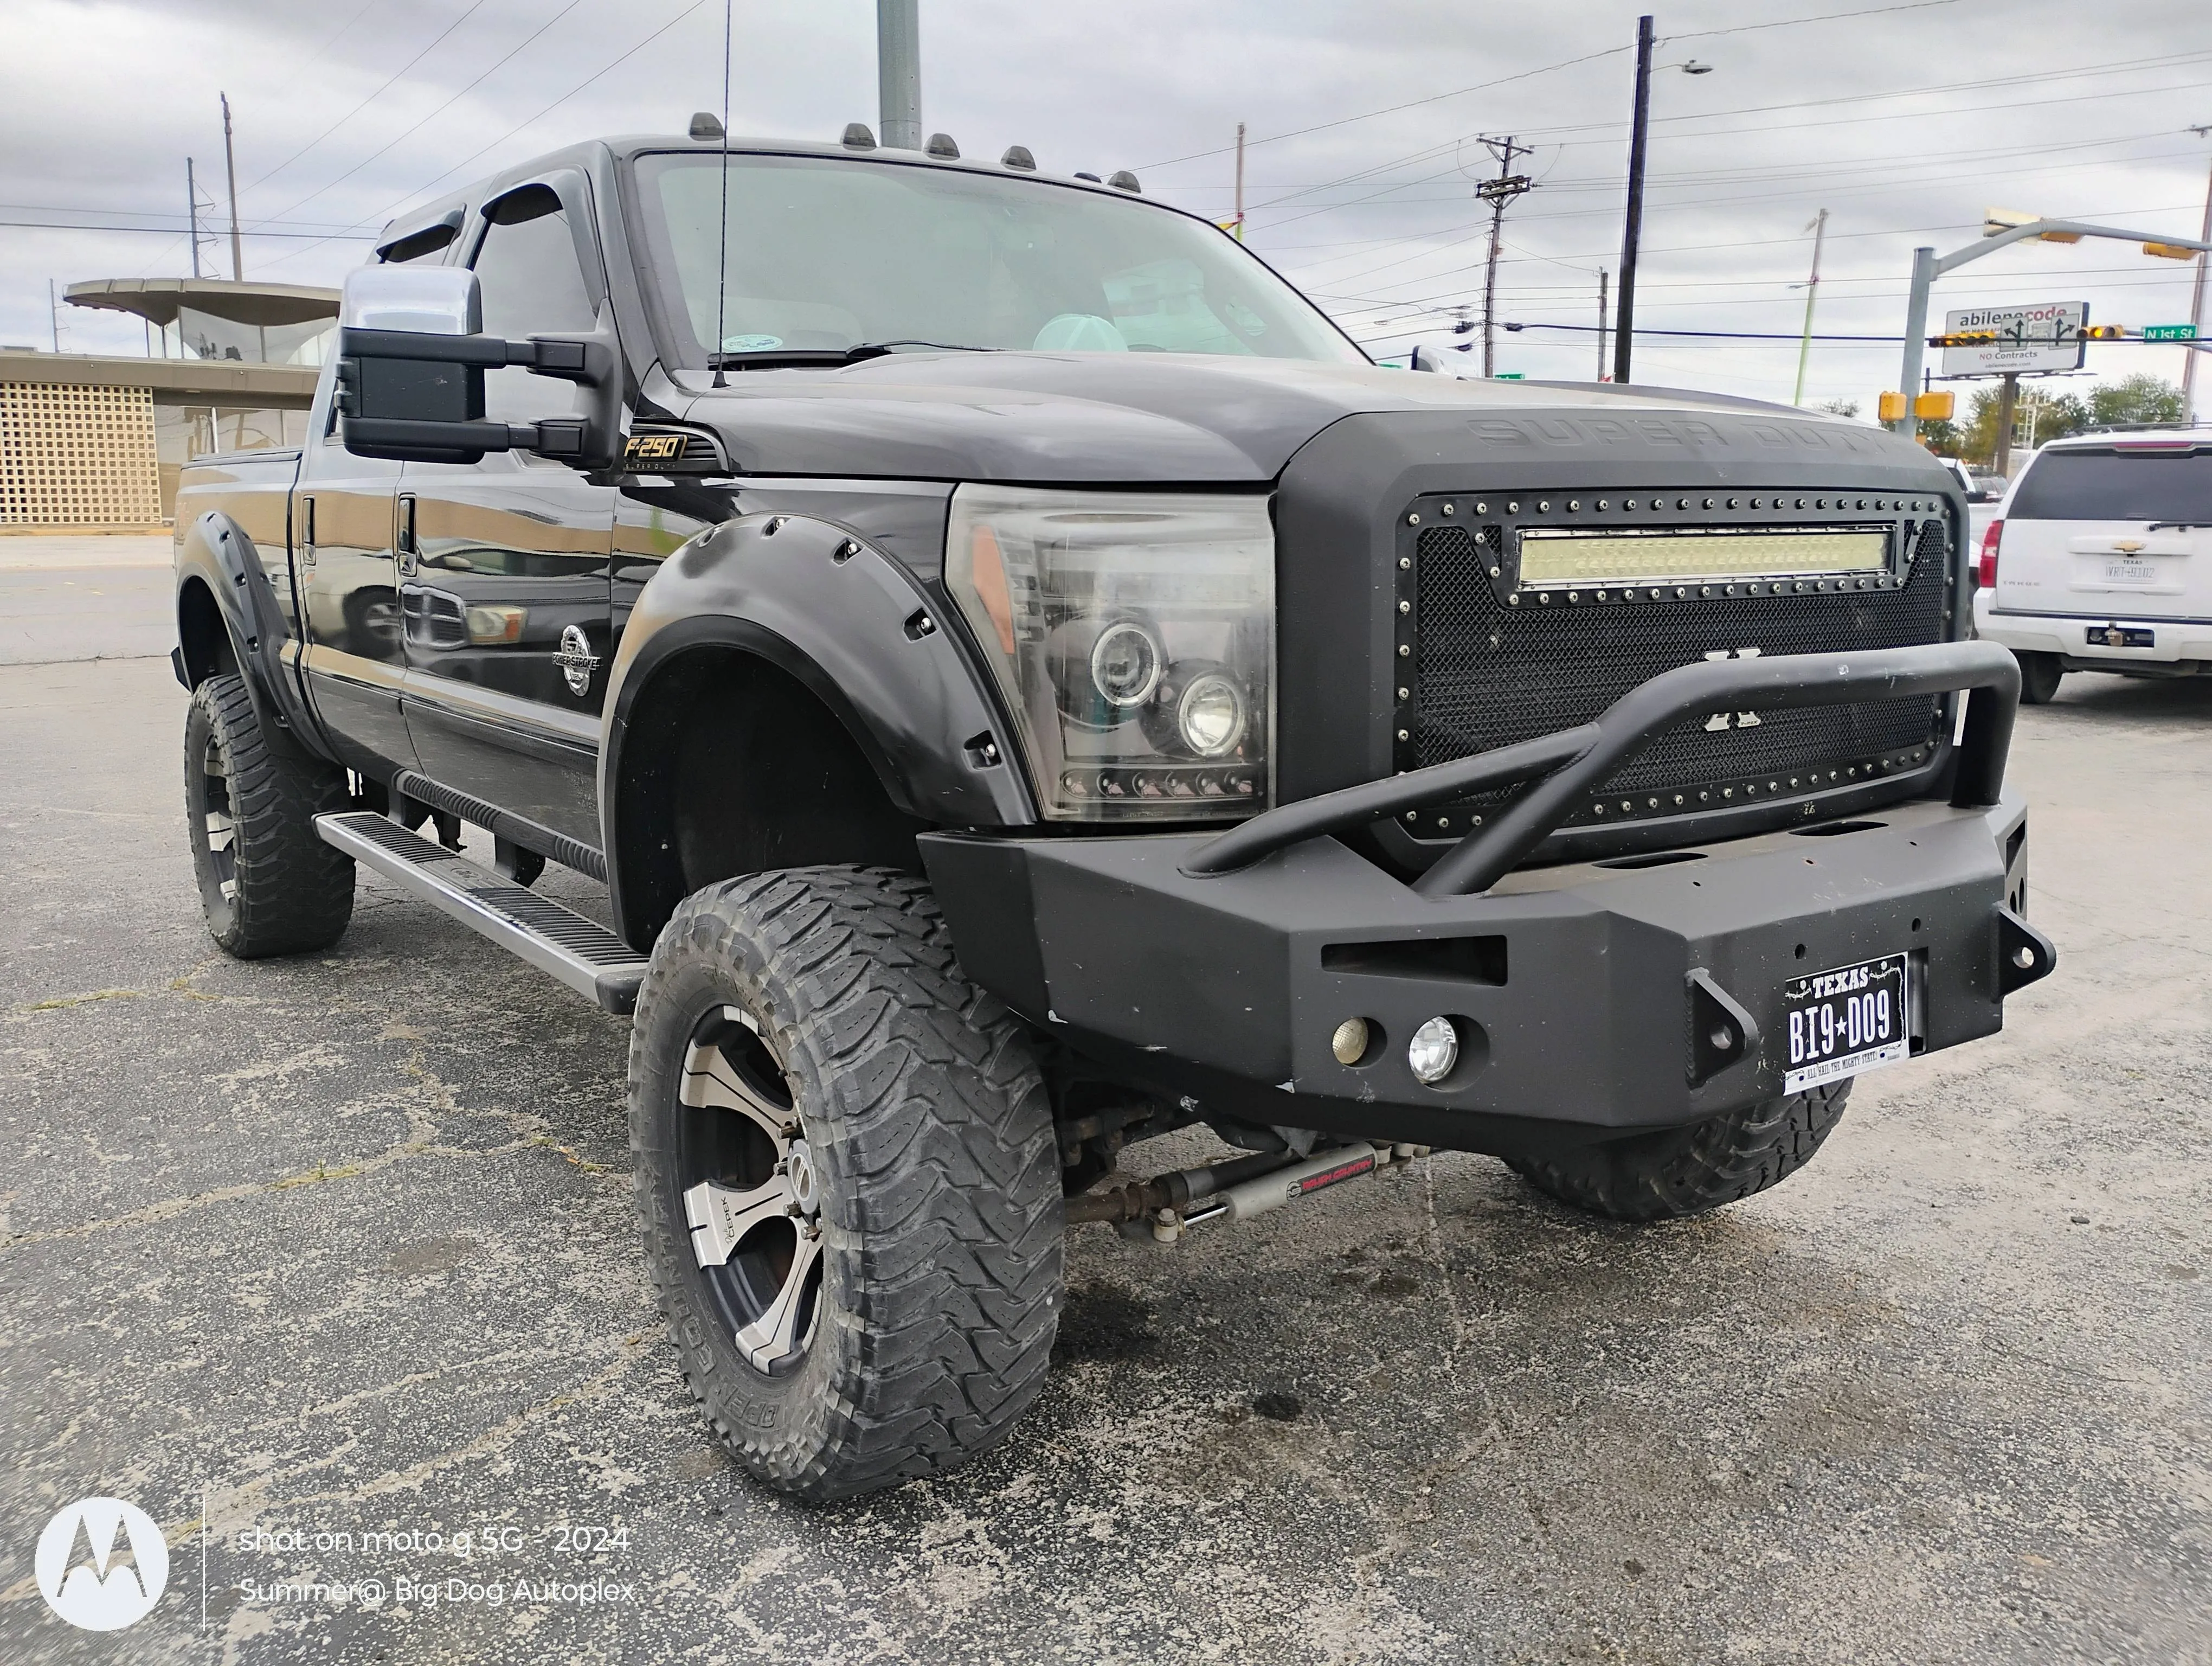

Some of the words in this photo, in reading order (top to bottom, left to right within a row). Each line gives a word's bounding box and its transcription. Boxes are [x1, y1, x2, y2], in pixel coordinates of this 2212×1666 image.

[2147, 329, 2157, 339] N
[2160, 329, 2176, 339] 1st
[2179, 328, 2194, 339] St
[1995, 351, 2038, 360] Contracts
[623, 437, 679, 457] F-250
[1467, 419, 1730, 447] SUPER
[1739, 423, 1887, 453] DUTY
[571, 656, 597, 670] STROKE
[1812, 966, 1868, 999] TEXAS
[1807, 1067, 1816, 1079] ALL
[1818, 1064, 1830, 1077] HAIL
[1831, 1061, 1841, 1072] THE
[1842, 1055, 1861, 1070] MIGHTY
[1862, 1050, 1877, 1064] STATE!
[1303, 1173, 1332, 1189] ROUGH
[1333, 1158, 1372, 1178] COUNTRY
[721, 1196, 735, 1238] CEPEK
